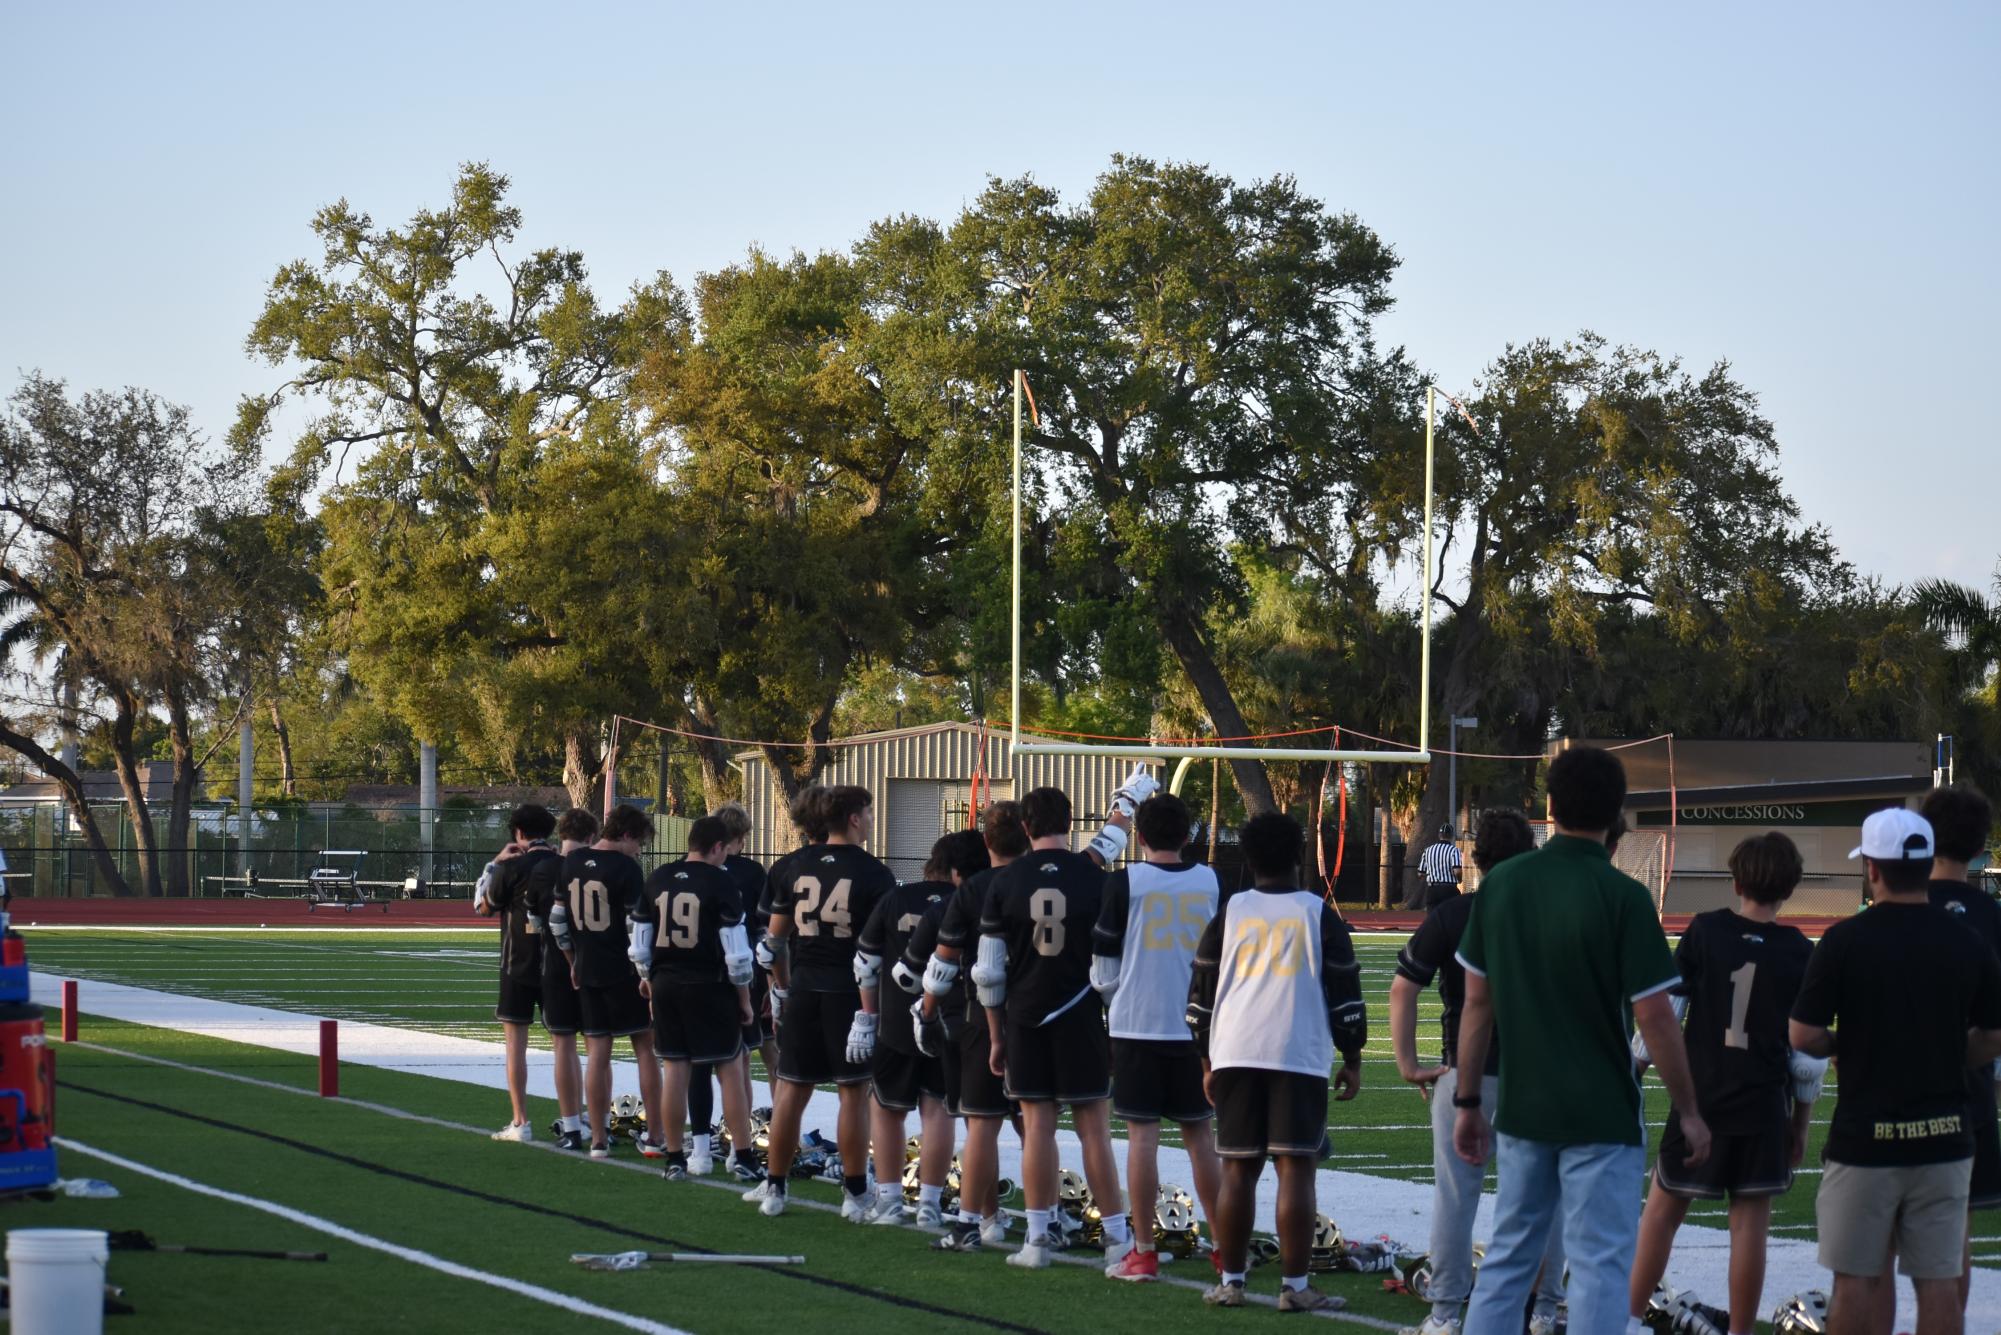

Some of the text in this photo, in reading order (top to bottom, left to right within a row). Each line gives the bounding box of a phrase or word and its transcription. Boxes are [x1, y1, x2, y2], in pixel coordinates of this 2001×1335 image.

[1681, 805, 1805, 820] CONCESSIONS
[568, 877, 611, 932] 10
[655, 891, 701, 949] 19
[793, 876, 853, 938] 24
[1030, 887, 1067, 957] 8
[1143, 890, 1209, 951] 25
[1236, 917, 1306, 977] 20
[1725, 961, 1757, 1051] 1
[1874, 1116, 1962, 1140] BE THE BEST
